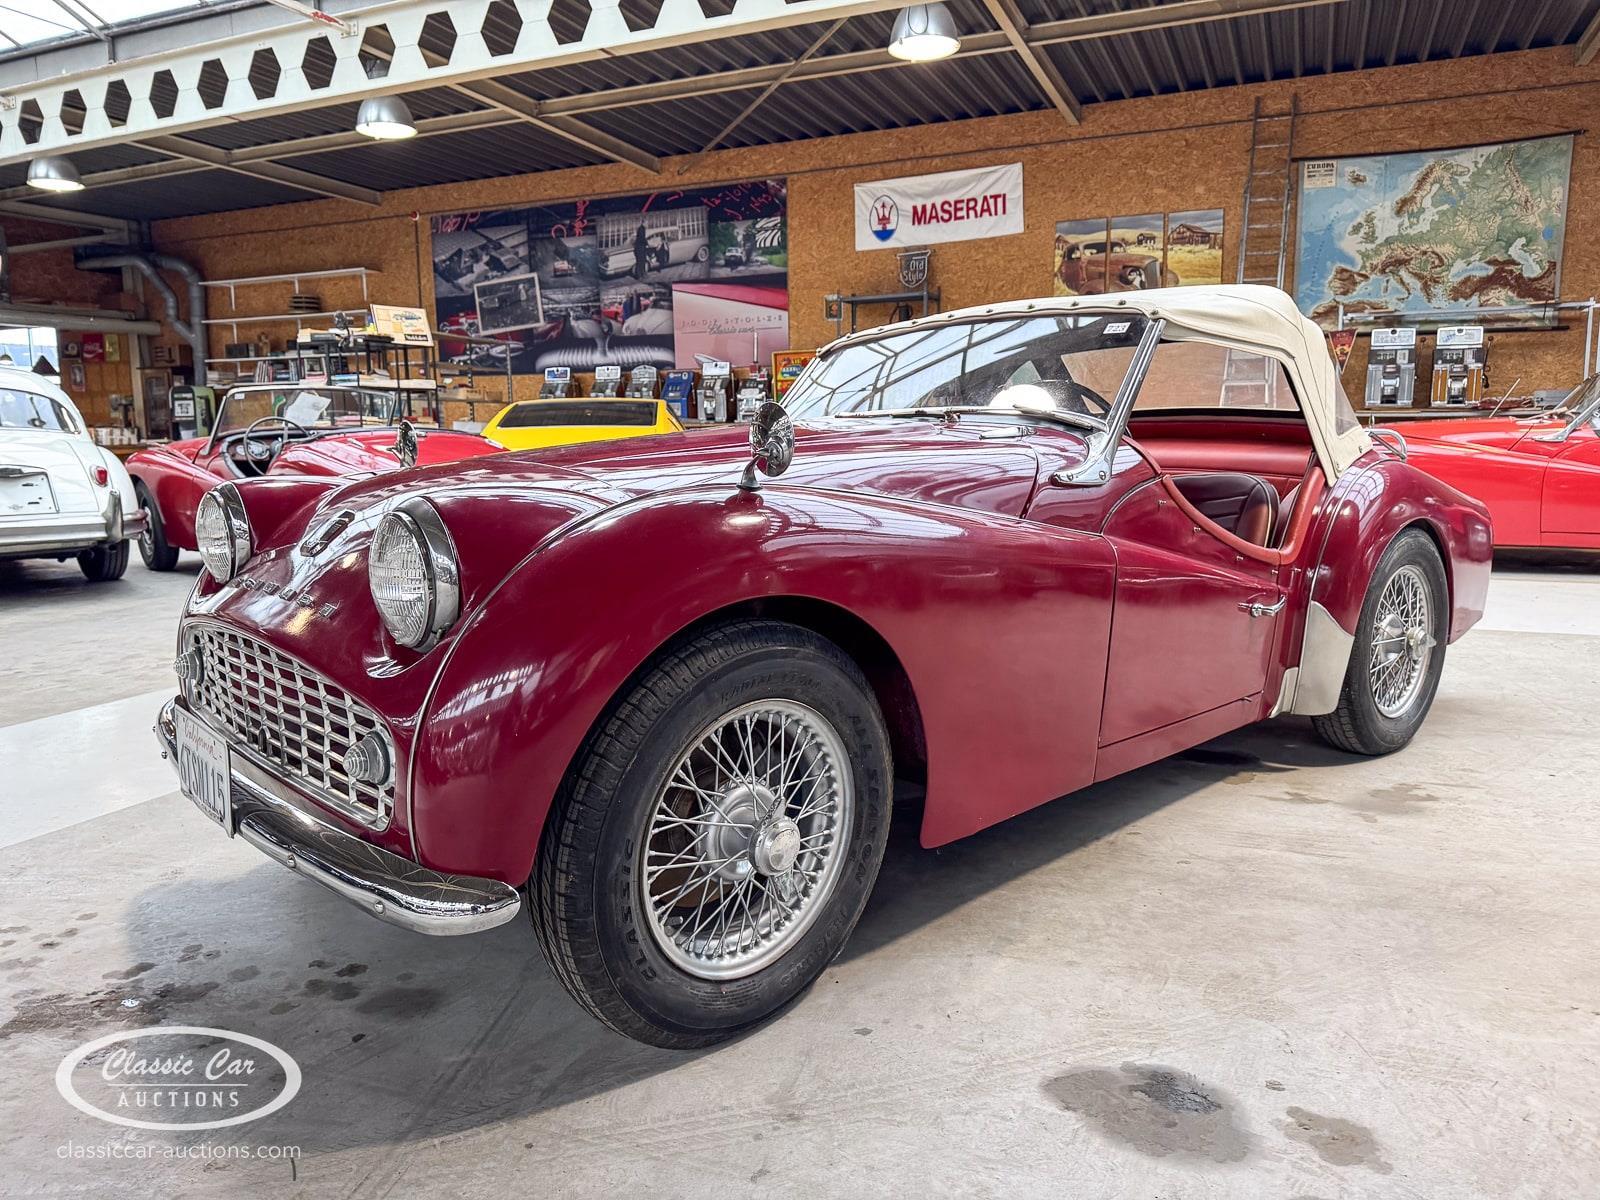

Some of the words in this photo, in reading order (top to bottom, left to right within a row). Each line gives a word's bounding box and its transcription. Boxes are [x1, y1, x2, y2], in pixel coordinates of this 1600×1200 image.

[911, 193, 1007, 226] MASERATI
[910, 259, 924, 271] Old
[902, 269, 924, 285] Style
